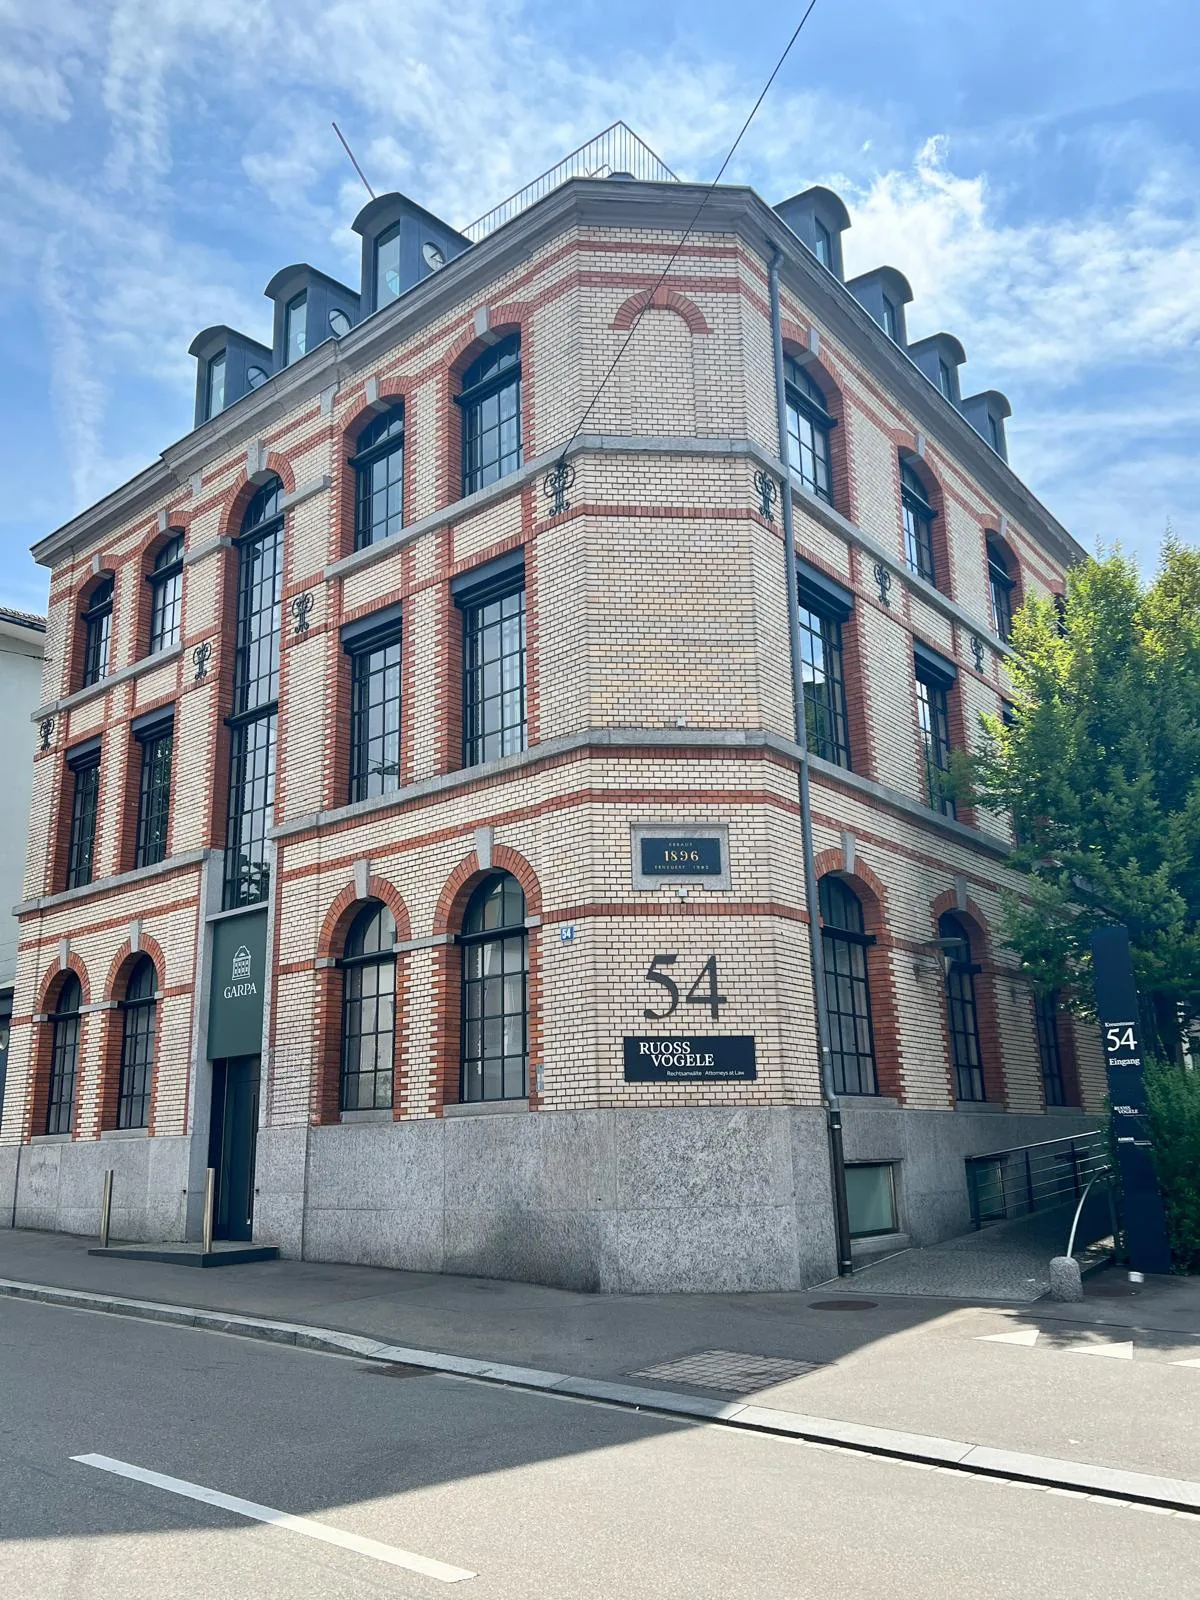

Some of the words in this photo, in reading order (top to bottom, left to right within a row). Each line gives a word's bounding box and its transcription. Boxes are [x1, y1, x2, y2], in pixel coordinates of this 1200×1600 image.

[664, 850, 699, 861] 1896
[562, 928, 571, 939] 54
[223, 982, 257, 999] GARPA
[643, 953, 728, 1020] 54
[1106, 1027, 1138, 1051] 54
[639, 1041, 691, 1054] RUOSS
[651, 1053, 715, 1067] VÖGELE
[1109, 1058, 1140, 1067] Eingang
